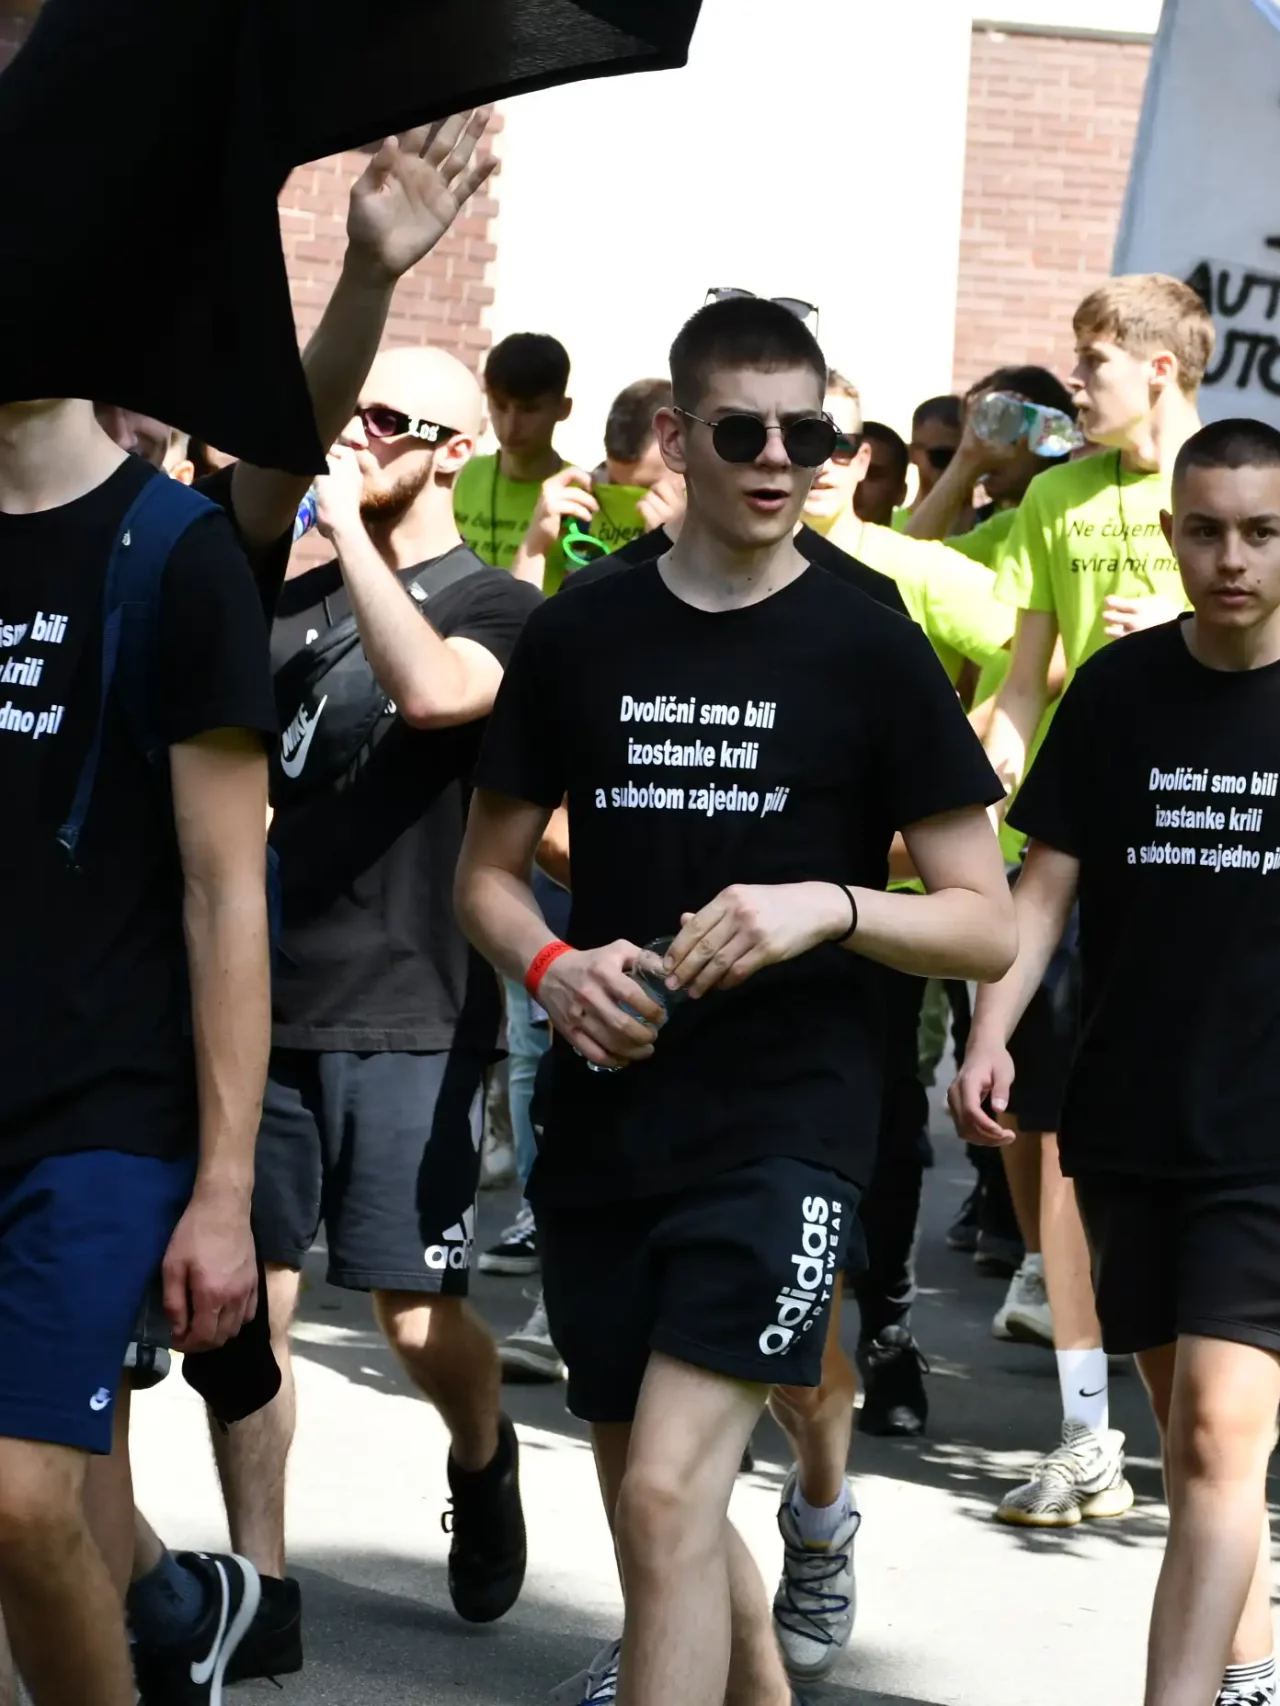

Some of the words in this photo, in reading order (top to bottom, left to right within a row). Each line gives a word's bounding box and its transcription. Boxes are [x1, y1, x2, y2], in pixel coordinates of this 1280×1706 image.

[1067, 520, 1095, 538] Ne
[30, 611, 68, 643] bili
[1, 656, 44, 687] krili
[619, 695, 696, 724] Dvolični
[699, 704, 740, 726] smo
[744, 700, 776, 729] bili
[628, 737, 716, 767] izostanke
[720, 740, 759, 770] krili
[1149, 767, 1209, 792] Dvolični
[1211, 774, 1247, 794] smo
[1250, 771, 1279, 797] bili
[595, 788, 607, 809] a
[611, 780, 685, 809] subotom
[688, 783, 759, 817] zajedno
[760, 786, 790, 819] pili
[1155, 804, 1226, 830] izostanke
[1229, 807, 1263, 832] krili
[1127, 846, 1136, 865] a
[1199, 843, 1260, 873] zajedno
[758, 1195, 829, 1356] adidas
